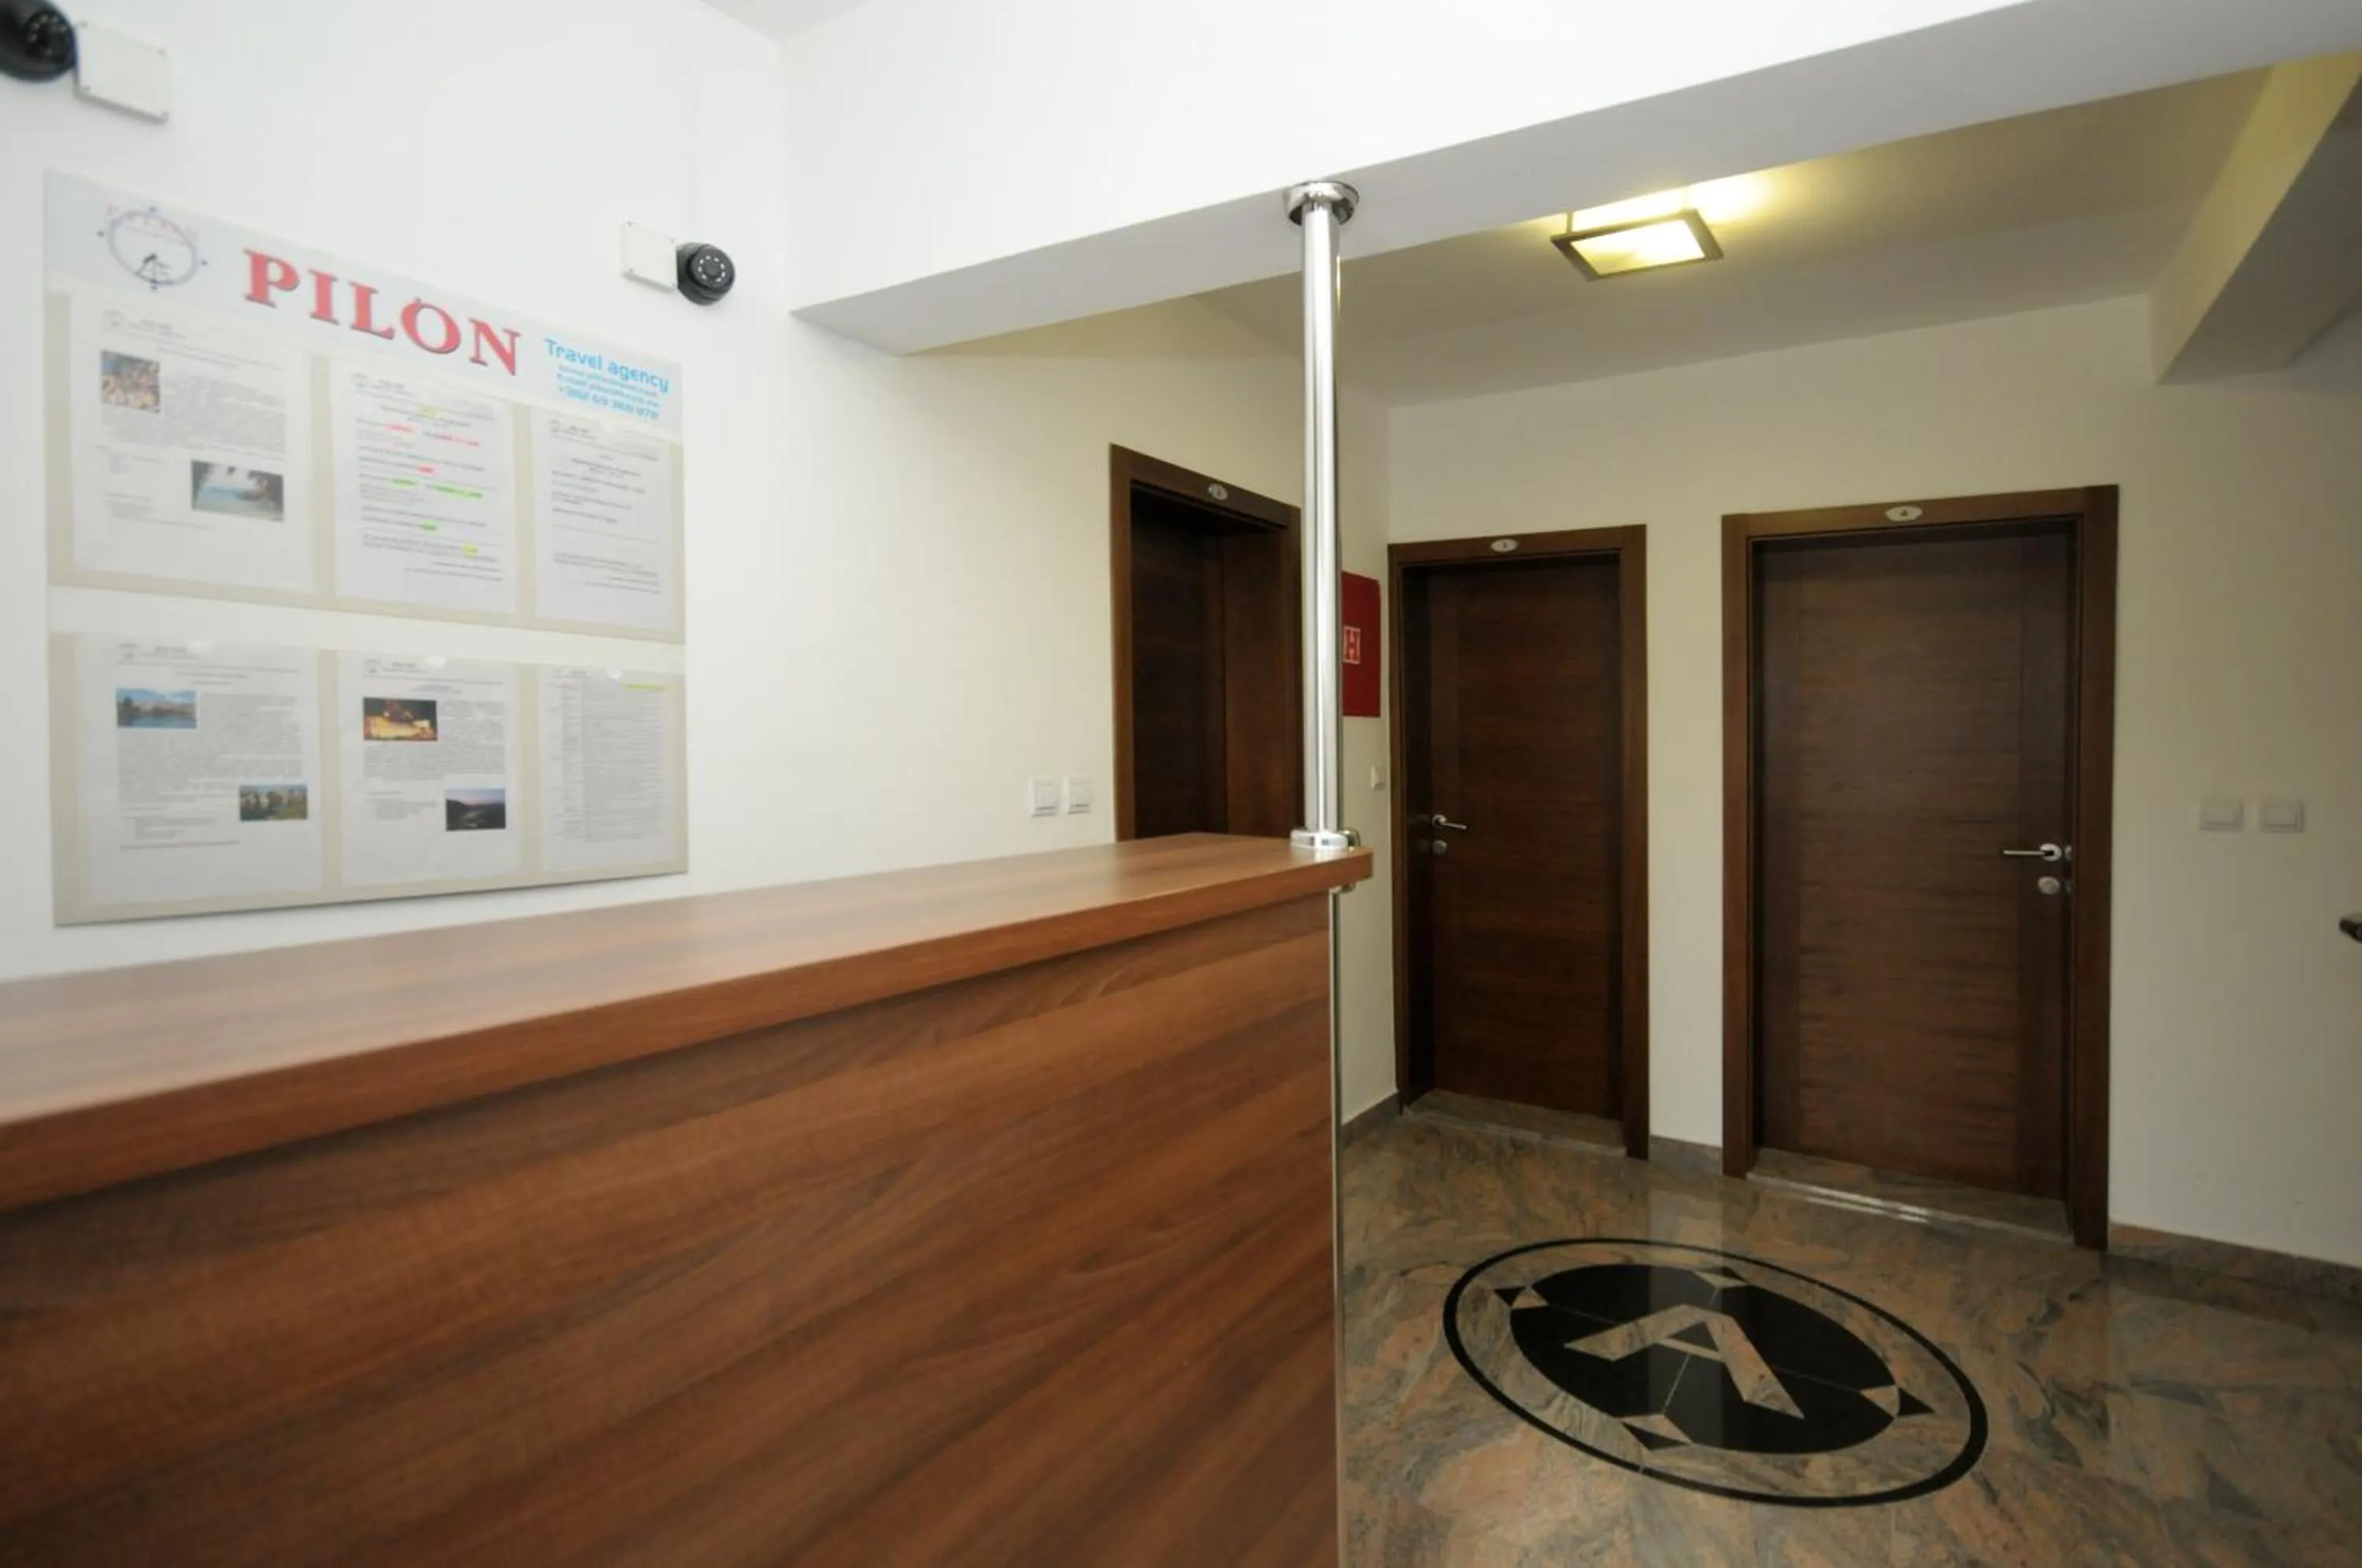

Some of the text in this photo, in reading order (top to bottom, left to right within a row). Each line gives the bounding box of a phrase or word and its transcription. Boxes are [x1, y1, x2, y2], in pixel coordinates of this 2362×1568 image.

[242, 248, 522, 376] PILON
[544, 337, 602, 370] Travel
[607, 361, 668, 393] agency
